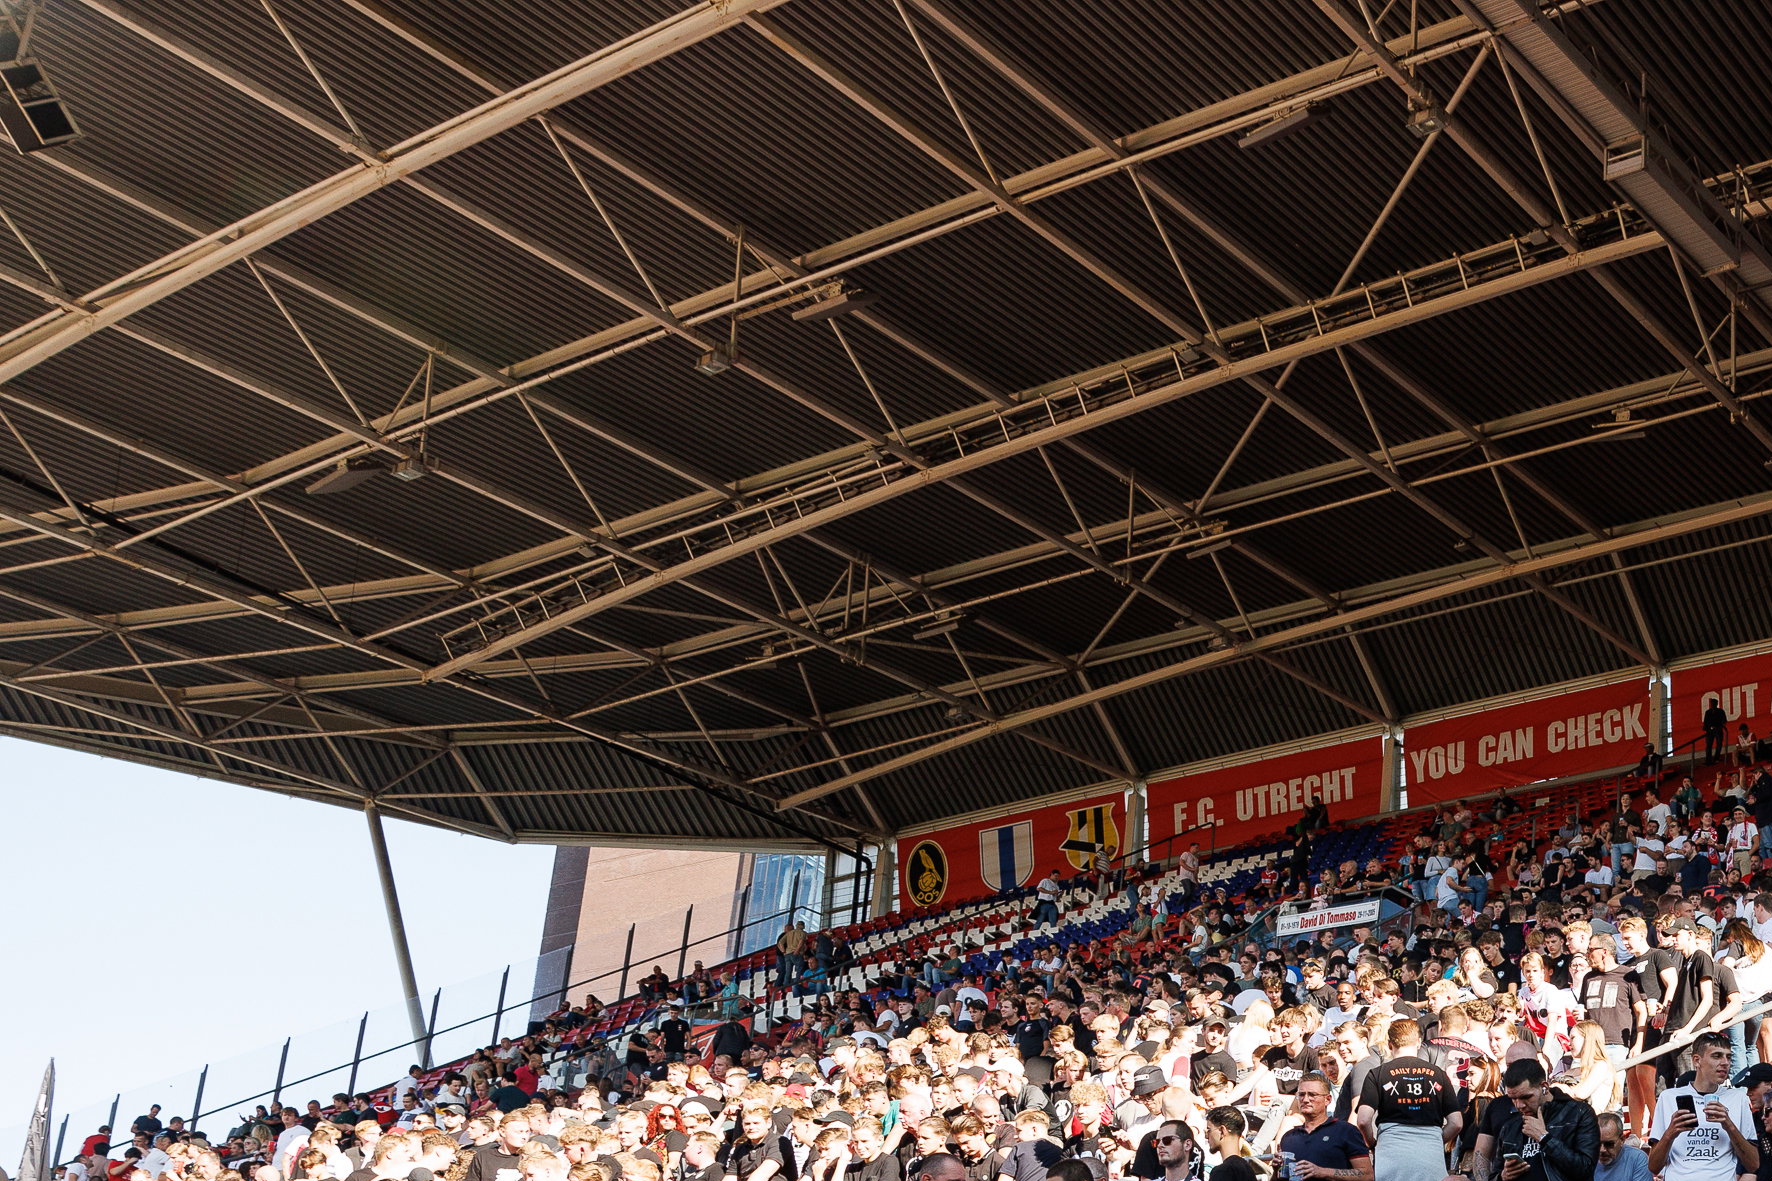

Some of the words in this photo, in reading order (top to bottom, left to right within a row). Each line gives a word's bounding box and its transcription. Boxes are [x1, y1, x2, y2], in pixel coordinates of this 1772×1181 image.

[1702, 682, 1758, 724] OUT
[1411, 741, 1466, 784] YOU
[1477, 726, 1534, 768] CAN
[1547, 703, 1648, 754] CHECK
[1173, 796, 1224, 835] F.C.
[1236, 767, 1356, 821] UTRECHT
[1300, 913, 1318, 929] David
[1319, 912, 1327, 925] Di
[1327, 910, 1357, 924] Tommaso
[1390, 1067, 1410, 1077] DAILY
[1412, 1067, 1435, 1077] PAPER
[1406, 1083, 1422, 1096] 18
[1414, 1096, 1430, 1104] YORK
[1687, 1128, 1719, 1141] Zorg
[1701, 1138, 1710, 1146] de
[1686, 1146, 1720, 1158] Zaak
